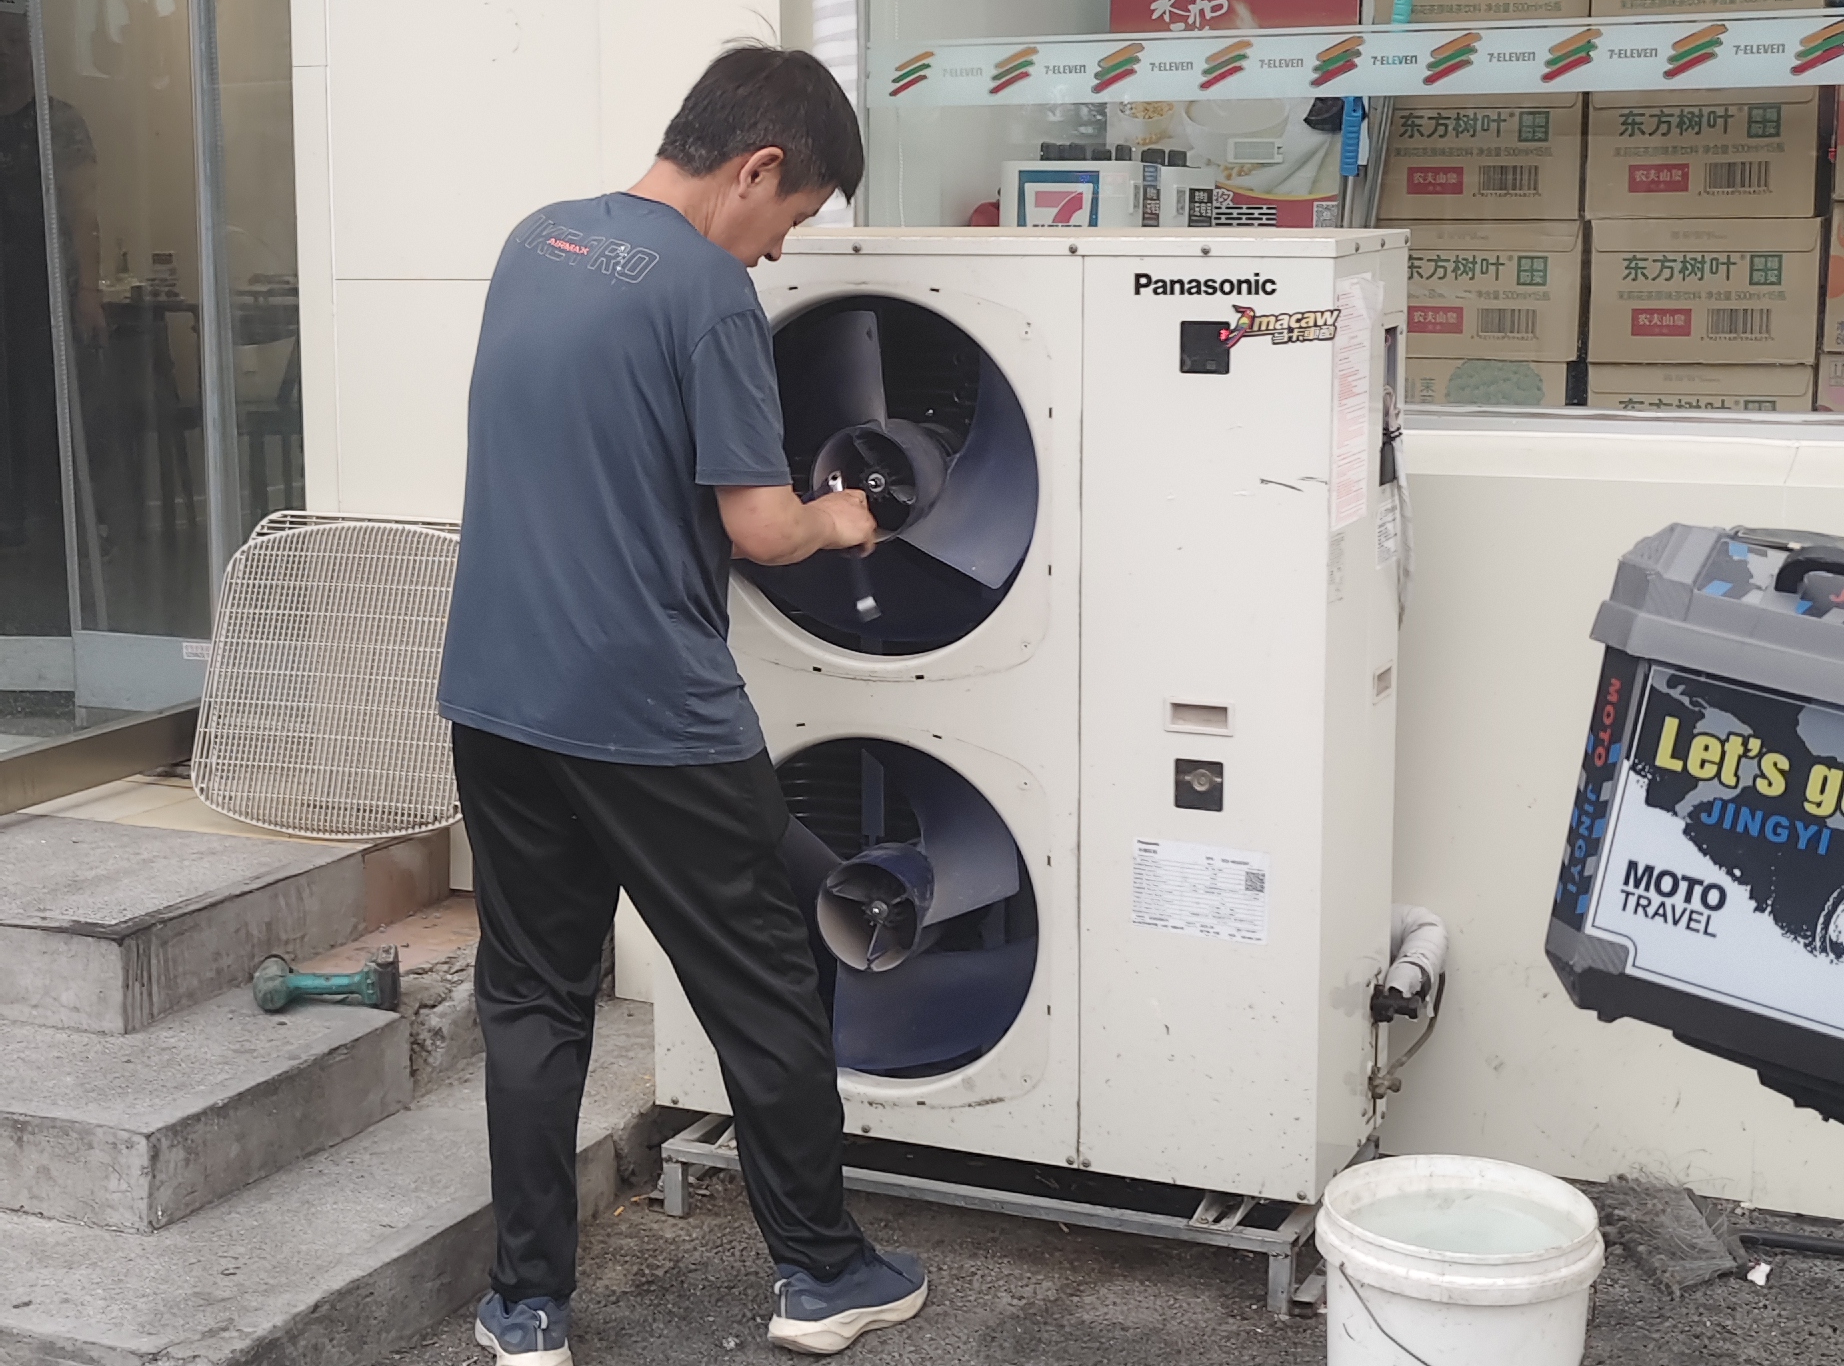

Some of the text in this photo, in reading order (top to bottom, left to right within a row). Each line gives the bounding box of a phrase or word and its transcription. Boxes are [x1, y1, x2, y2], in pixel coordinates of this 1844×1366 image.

[1399, 111, 1507, 139] 东方树叶
[1618, 107, 1735, 138] 东方树叶
[1412, 172, 1458, 185] 农夫山泉
[1634, 169, 1683, 182] 农夫山泉
[1408, 254, 1506, 281] 东方树叶
[1622, 254, 1737, 282] 东方树叶
[1134, 273, 1277, 296] Panasonic
[1253, 309, 1341, 332] macaw
[1594, 679, 1621, 767] MOTO
[1805, 763, 1844, 819] g
[1566, 784, 1599, 895] JINGYI
[1700, 799, 1833, 856] JINGYI
[1622, 860, 1727, 913] MOTO
[1620, 890, 1718, 938] TRAVEL
